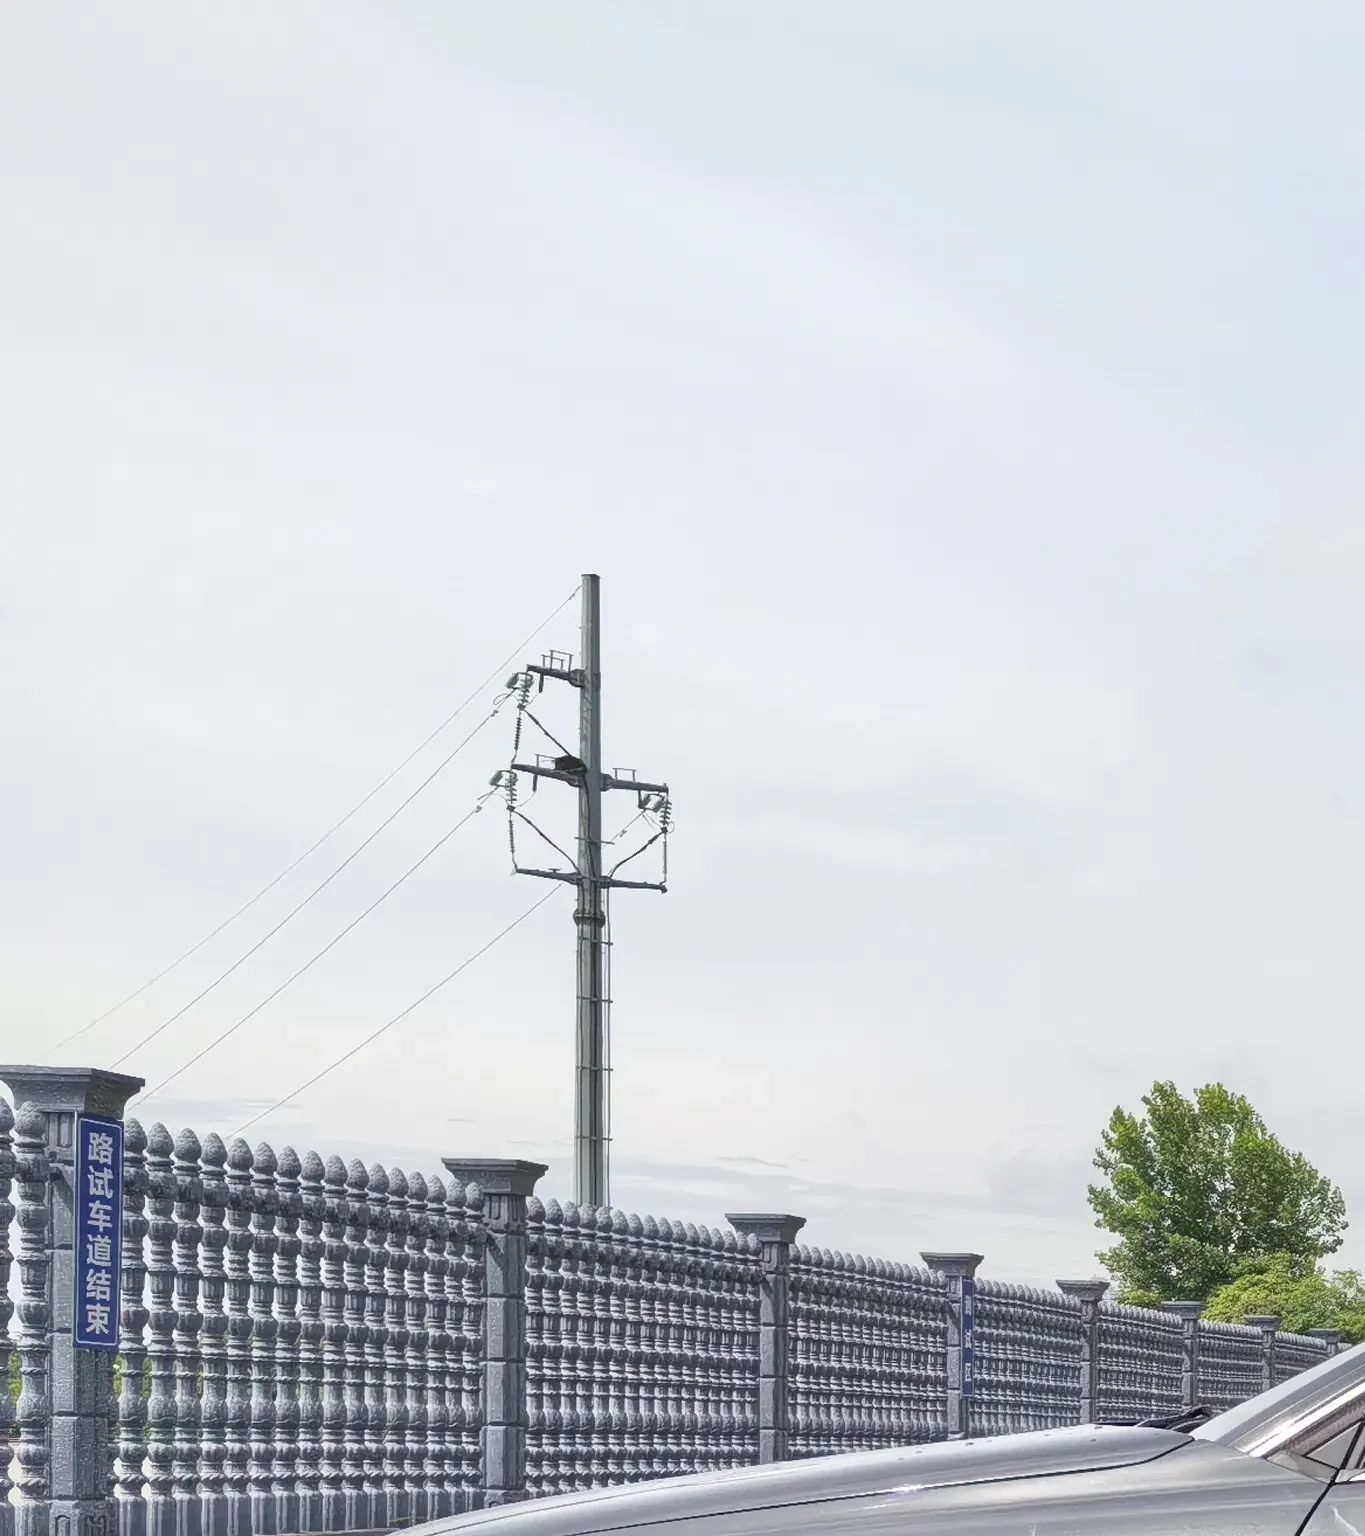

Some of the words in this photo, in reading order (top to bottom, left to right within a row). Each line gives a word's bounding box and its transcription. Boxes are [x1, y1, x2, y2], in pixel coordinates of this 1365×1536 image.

[86, 1132, 114, 1334] 路试车道结束
